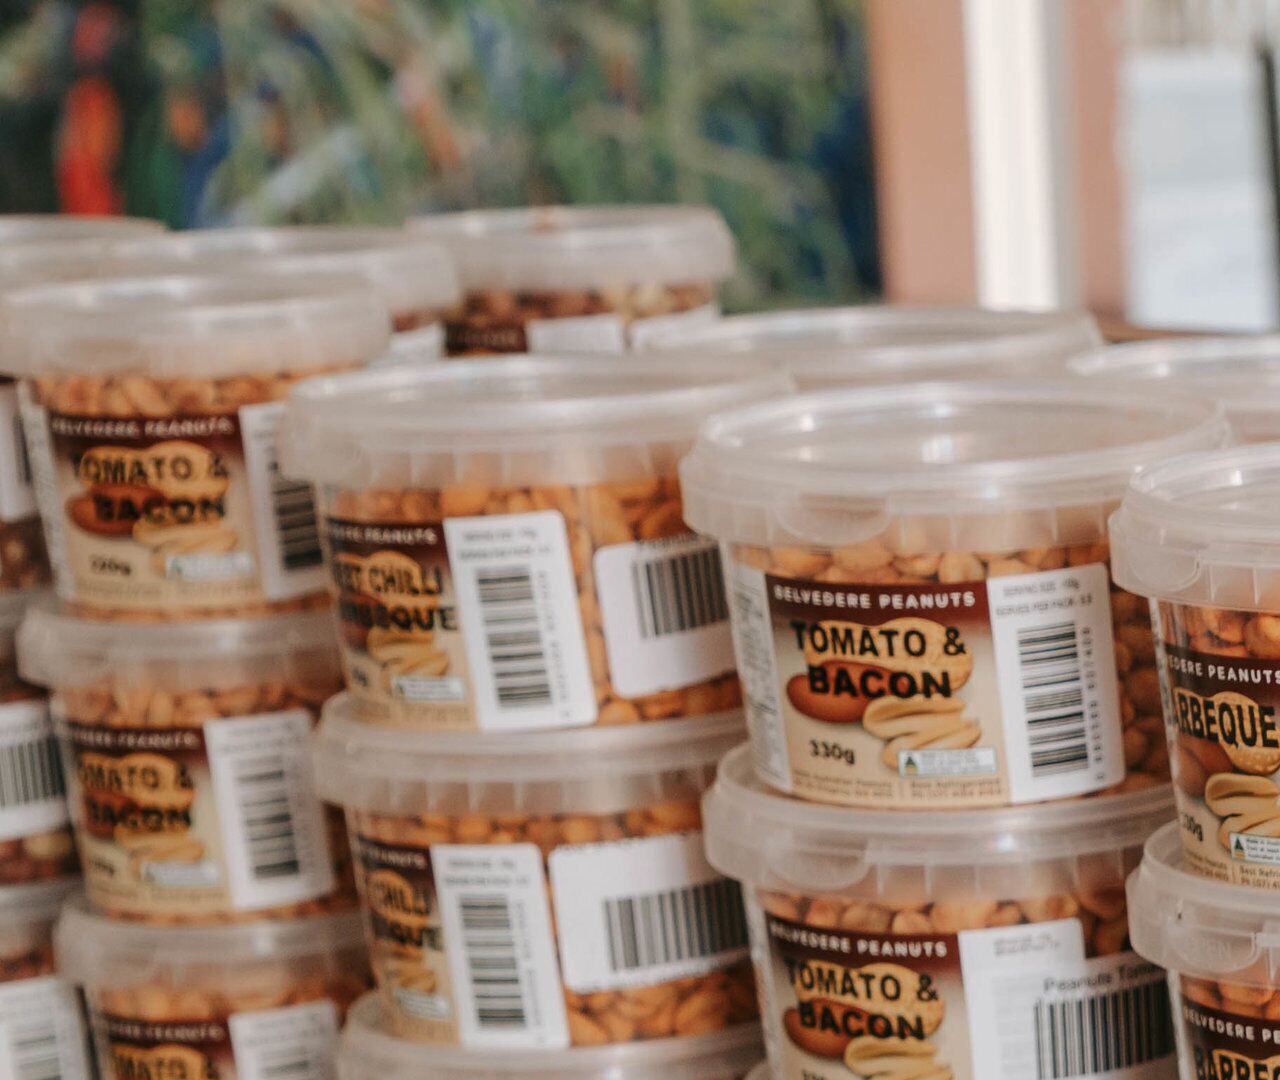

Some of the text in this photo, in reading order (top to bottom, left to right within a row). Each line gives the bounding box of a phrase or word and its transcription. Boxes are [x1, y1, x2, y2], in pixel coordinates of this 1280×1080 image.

[773, 585, 975, 610] BELVEDERE PEANUTS
[791, 621, 966, 657] TOMATO &
[808, 666, 952, 698] BACON
[1177, 694, 1279, 748] RBEQUE
[809, 741, 855, 765] 330g
[858, 938, 947, 957] PEANUTS
[786, 958, 939, 1000] TOMATO &
[799, 1002, 925, 1040] BACON
